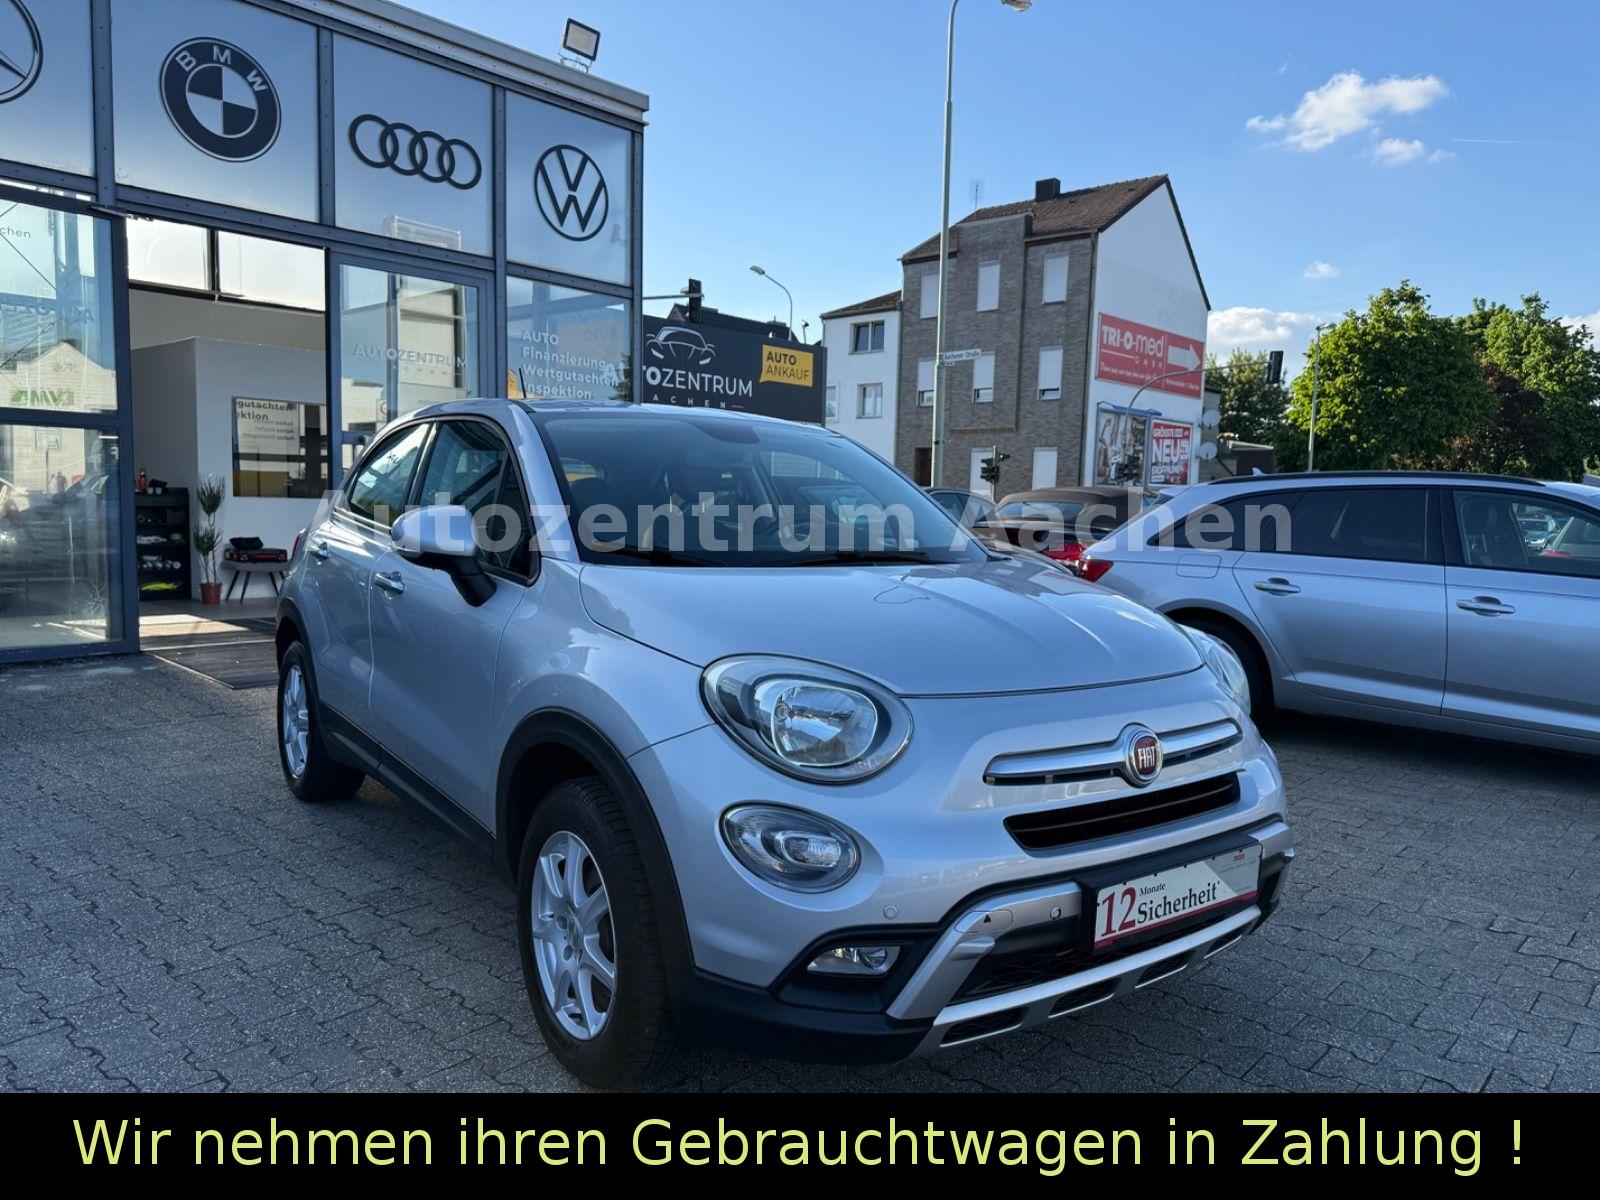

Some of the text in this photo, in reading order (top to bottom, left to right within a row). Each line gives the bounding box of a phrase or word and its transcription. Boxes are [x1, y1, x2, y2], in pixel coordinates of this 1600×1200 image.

[175, 44, 268, 92] BMW
[522, 330, 559, 345] AUTO
[352, 343, 468, 369] AUTOZENTRUM
[522, 346, 606, 371] Finanzierung
[766, 351, 797, 366] AUTO
[523, 363, 619, 388] Wertgutachten
[766, 363, 810, 382] ANKAUF
[1138, 746, 1155, 769] FIAT
[1101, 881, 1166, 937] 12 Monate
